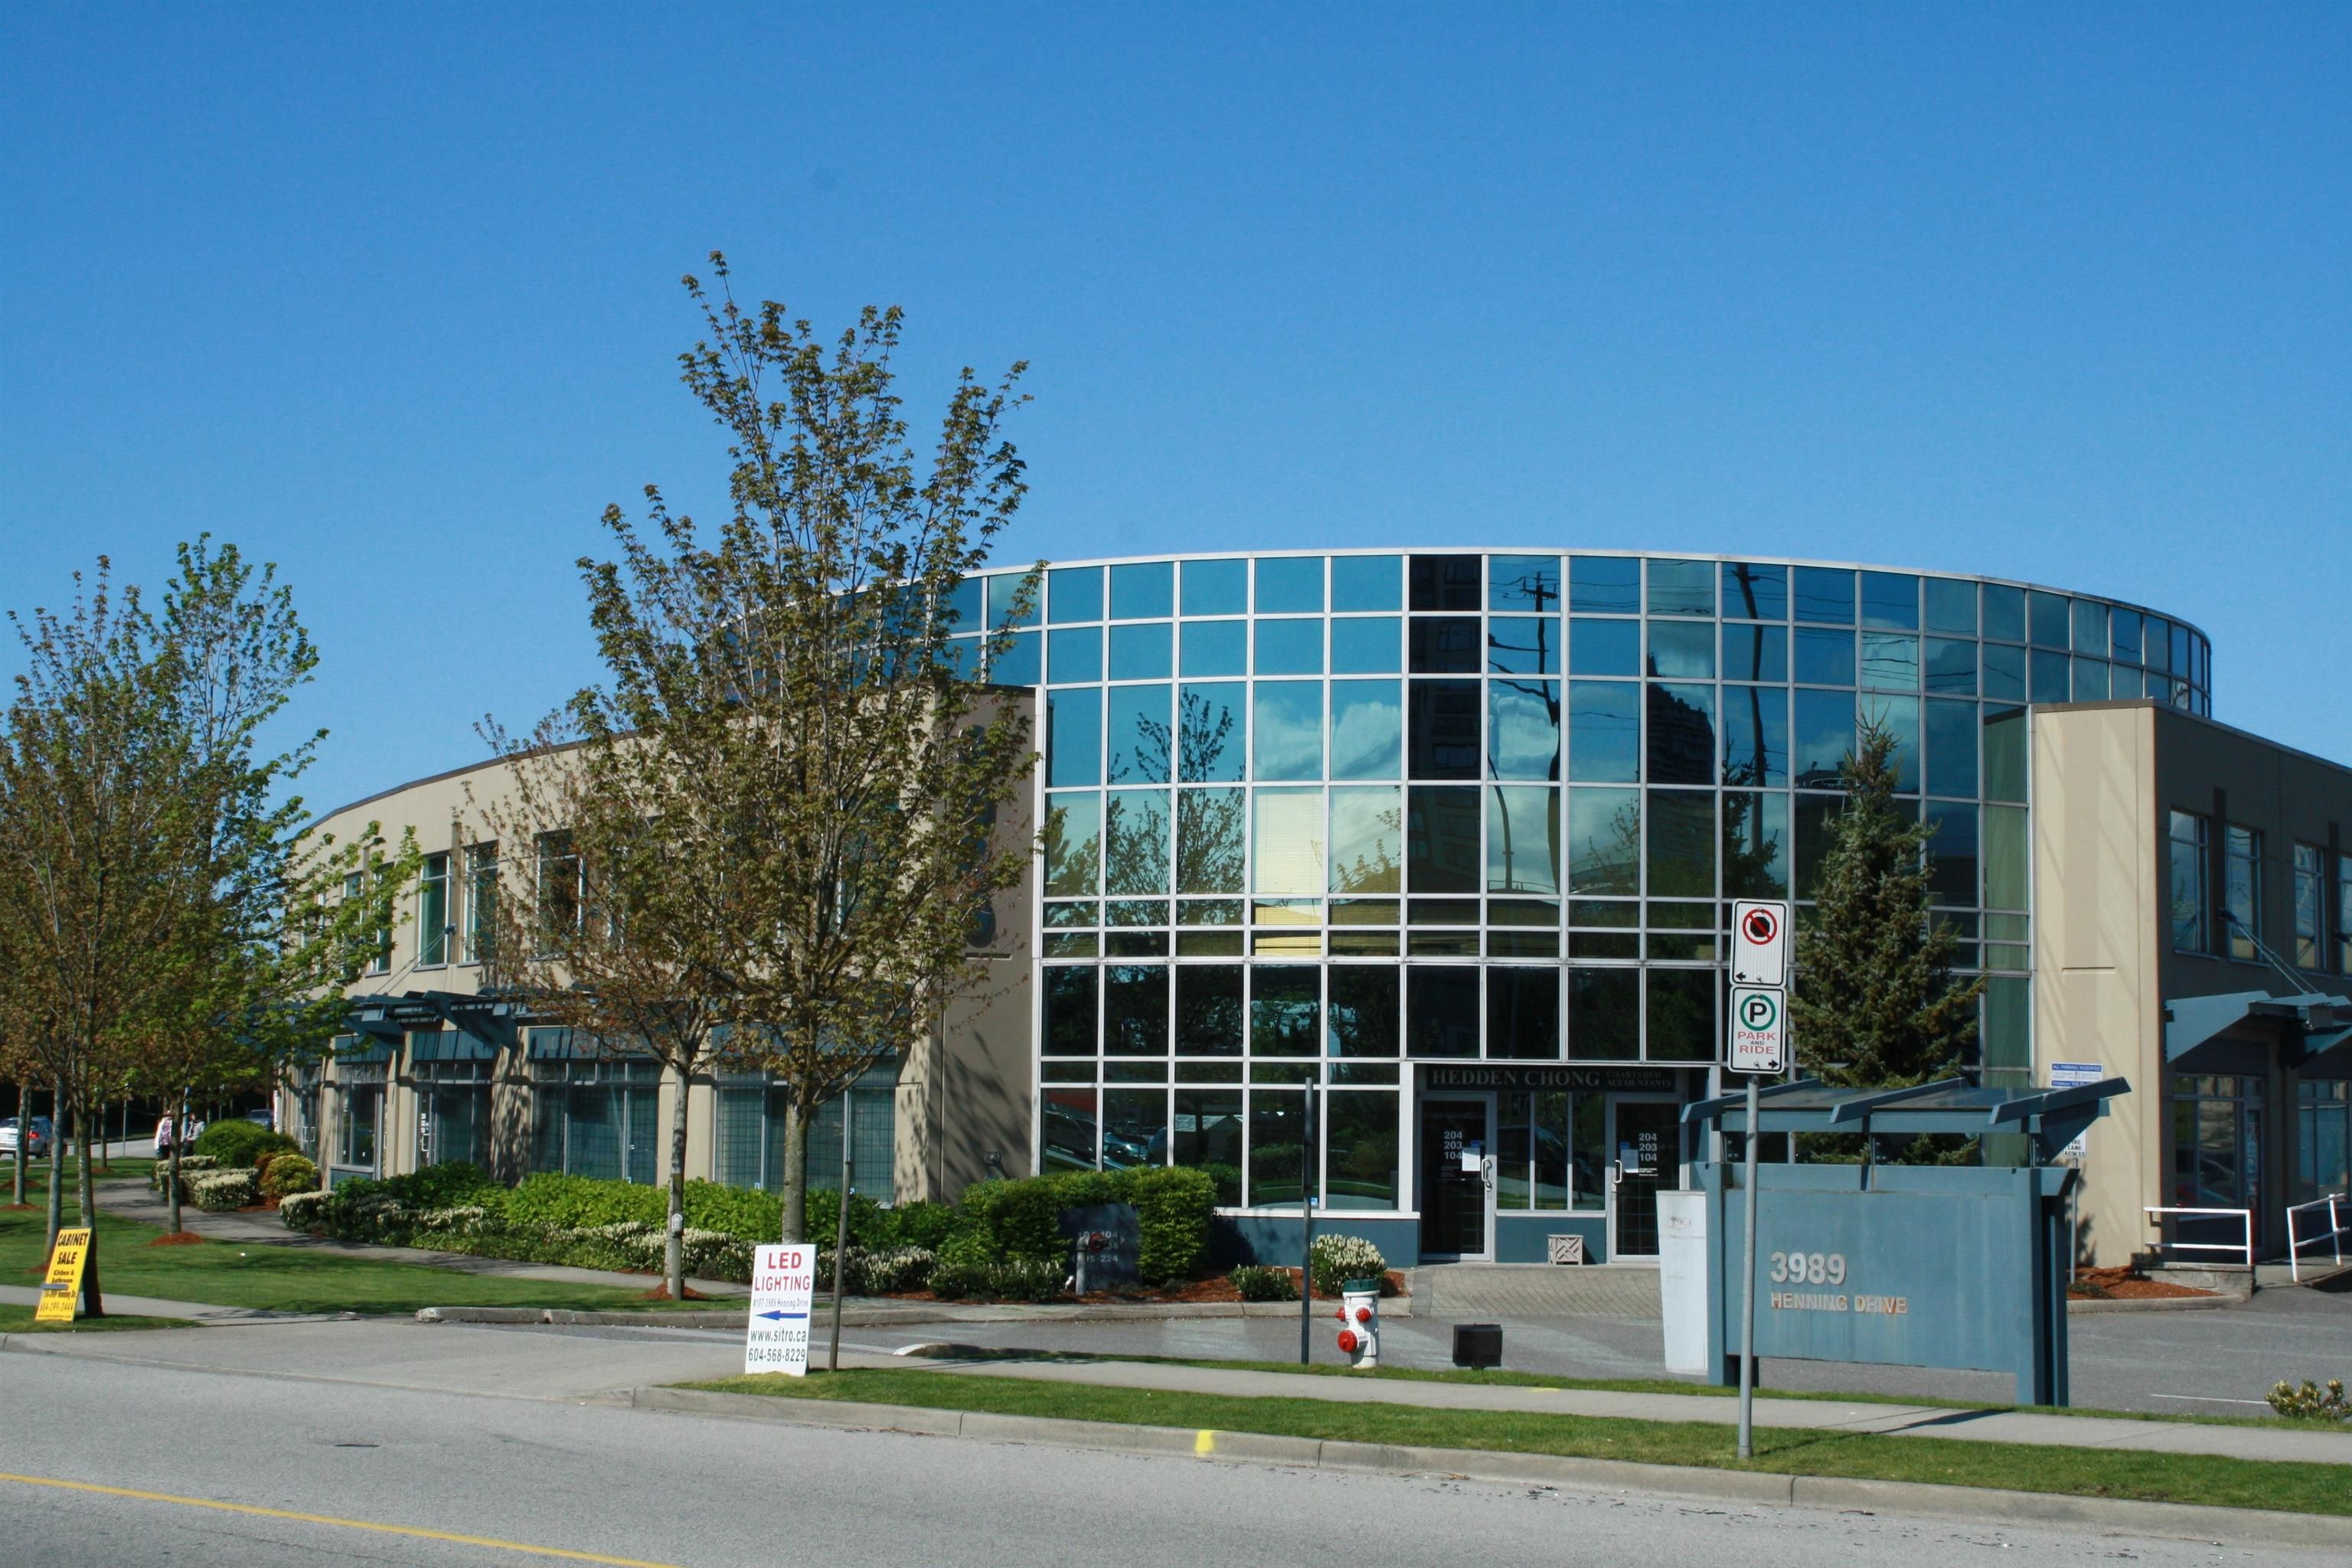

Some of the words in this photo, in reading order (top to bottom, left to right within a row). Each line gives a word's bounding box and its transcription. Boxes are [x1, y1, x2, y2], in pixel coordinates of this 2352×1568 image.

[1749, 1002, 1767, 1022] P
[1738, 1031, 1775, 1040] PARK
[1740, 1046, 1774, 1054] RIDE
[1432, 1070, 1517, 1086] HEDDEN
[1524, 1070, 1600, 1086] CHONG
[1444, 1131, 1462, 1139] 204
[1639, 1133, 1658, 1142] 204
[1444, 1141, 1462, 1149] 203
[1639, 1142, 1658, 1152] 203
[1640, 1153, 1658, 1161] 104
[57, 1233, 88, 1246] CABINET
[57, 1252, 77, 1265] SALE
[768, 1252, 802, 1269] LED
[1770, 1251, 1847, 1285] 3989
[755, 1276, 810, 1292] LIGHTING
[1771, 1292, 1847, 1312] HENNING
[1854, 1295, 1907, 1314] DRIVE
[750, 1327, 806, 1342] www.sitro.ca
[748, 1348, 805, 1362] 604-568-8229
